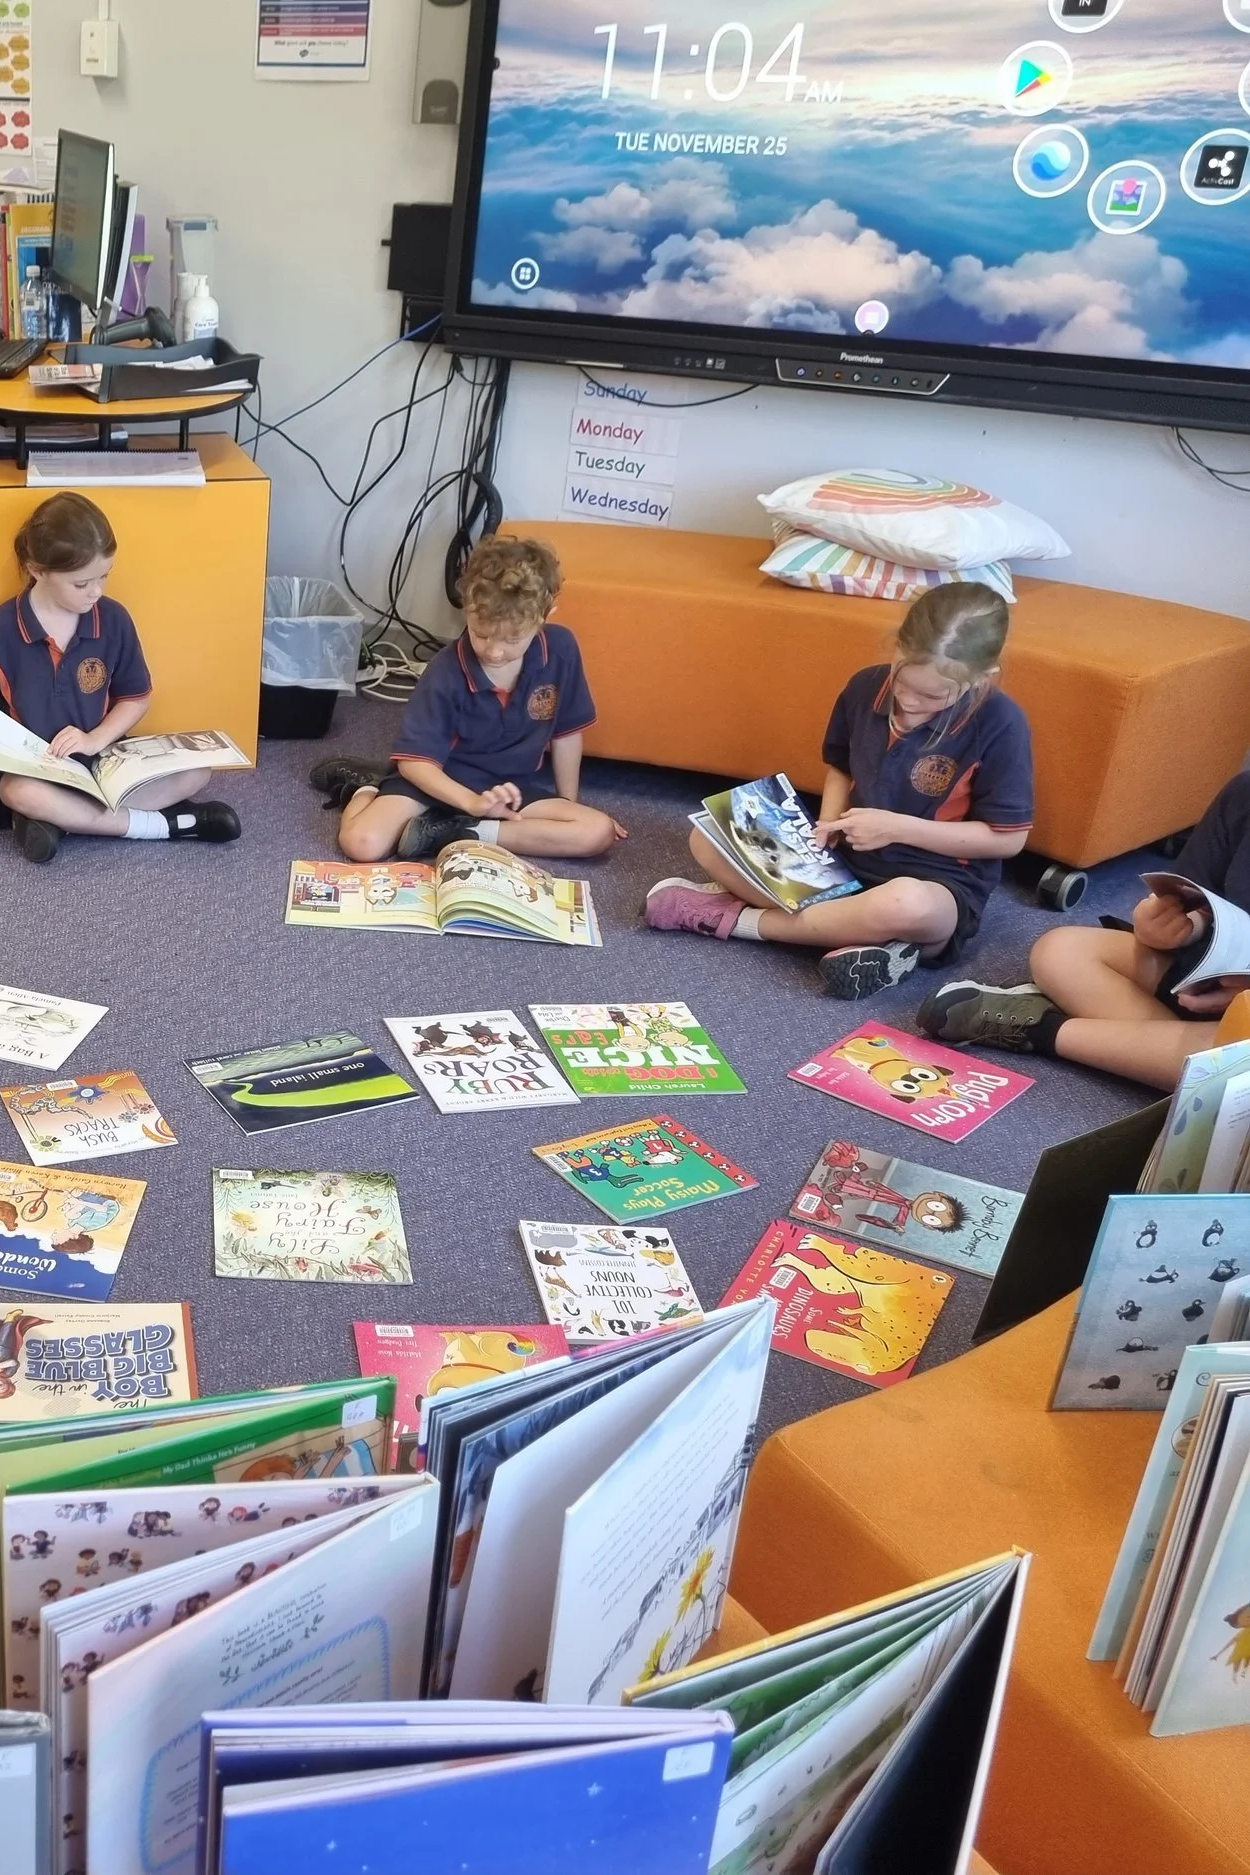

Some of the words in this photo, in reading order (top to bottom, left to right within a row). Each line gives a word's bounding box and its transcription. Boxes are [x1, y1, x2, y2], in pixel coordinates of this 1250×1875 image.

[593, 21, 807, 103] 11:04
[804, 82, 844, 103] AM
[615, 132, 649, 152] TUE
[654, 133, 759, 155] NOVEMBER
[762, 136, 788, 156] 25
[839, 352, 884, 365] Promethean
[584, 381, 648, 404] Sunday
[576, 418, 644, 445] Monday
[575, 451, 646, 476] Tuesday
[570, 486, 670, 522] Wednesday
[8, 1044, 34, 1058] Bag
[38, 1051, 50, 1060] A
[560, 1043, 721, 1068] NICE
[308, 1066, 341, 1081] small
[342, 1062, 365, 1072] one
[624, 1065, 706, 1081] DOG
[269, 1073, 307, 1088] island
[444, 1071, 555, 1095] RUBY
[628, 1083, 662, 1091] Child
[63, 1116, 120, 1137] TRACKS
[610, 1149, 620, 1157] 2
[588, 1168, 602, 1177] 3
[633, 1177, 685, 1197] Soccer
[664, 1179, 720, 1202] Maisy
[249, 1198, 347, 1217] House
[622, 1195, 666, 1212] Plays
[274, 1212, 366, 1236] Fairy
[267, 1232, 340, 1256] Lily
[746, 1230, 784, 1284] CHARLOTTE
[590, 1270, 636, 1283] NOUNS
[583, 1283, 653, 1298] COLLECTIVE
[611, 1299, 637, 1315] 101
[772, 1287, 814, 1339] DINOSAURS
[25, 1323, 173, 1360] GLASSES
[24, 1357, 107, 1381] BLUE
[112, 1348, 173, 1379] BIG
[31, 1382, 66, 1395] the
[68, 1383, 88, 1393] in
[91, 1374, 168, 1402] BOY
[162, 1466, 173, 1474] My
[175, 1461, 190, 1472] Dad
[192, 1453, 217, 1468] Thinks
[218, 1448, 233, 1461] He's
[233, 1441, 257, 1456] Funny
